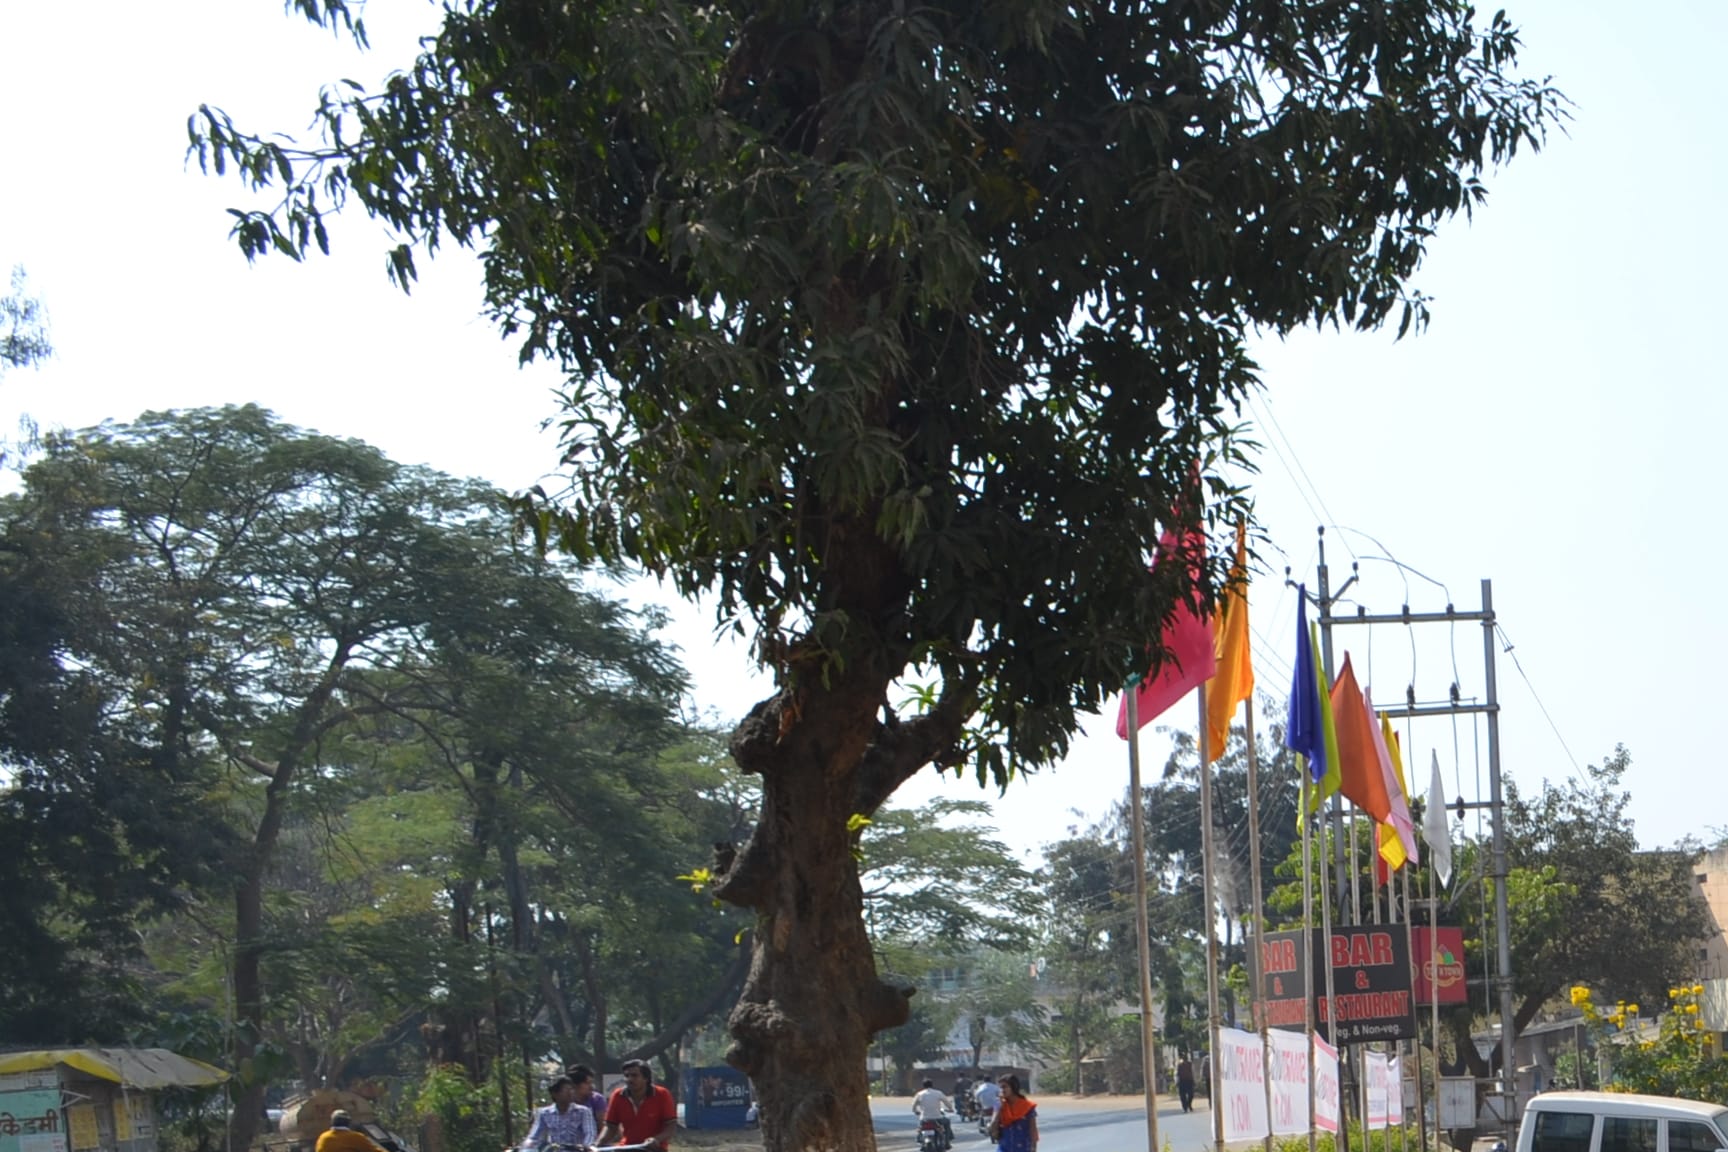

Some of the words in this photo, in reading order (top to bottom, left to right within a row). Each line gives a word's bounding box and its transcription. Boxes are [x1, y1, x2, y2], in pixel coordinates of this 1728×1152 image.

[1331, 932, 1394, 968] BAR
[1355, 970, 1370, 989] &
[1318, 991, 1409, 1023] RSTAURANT
